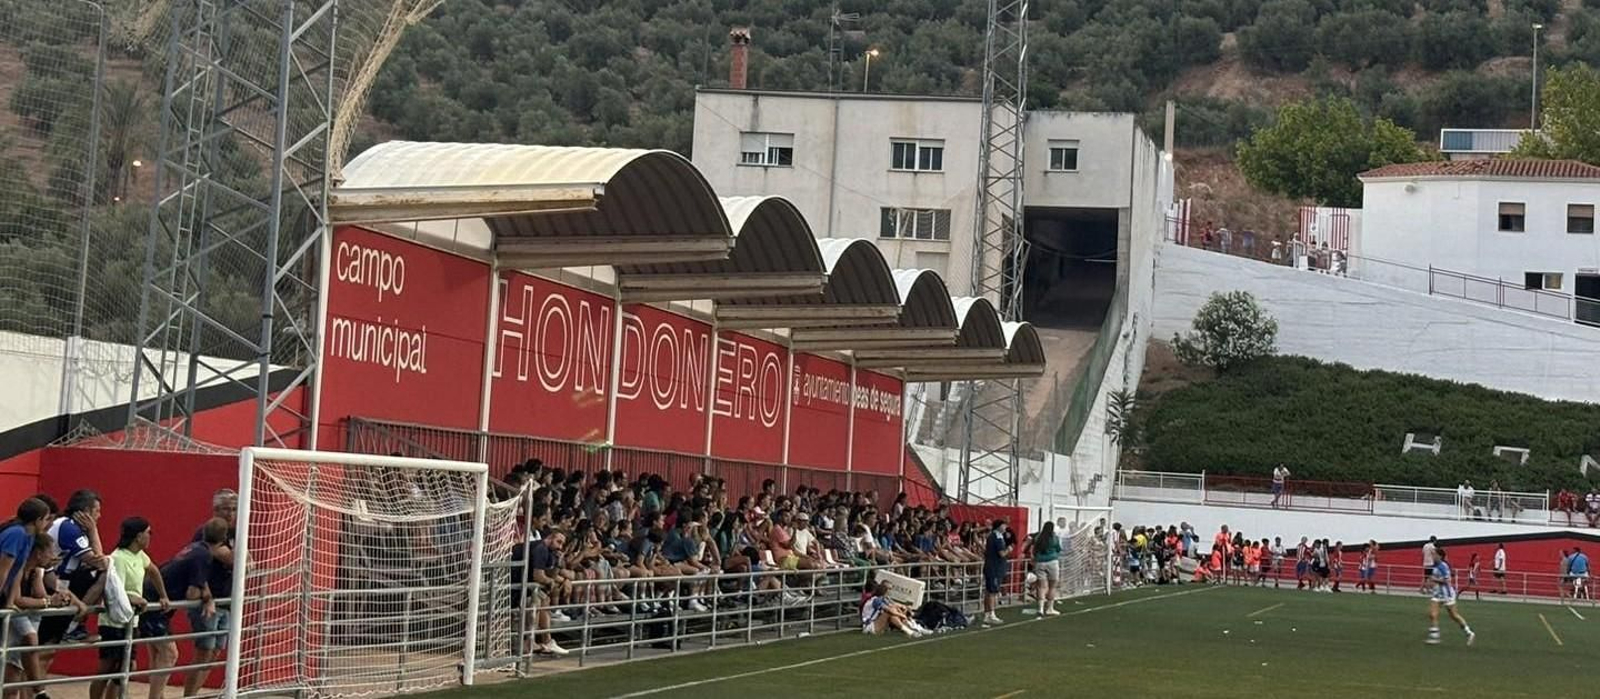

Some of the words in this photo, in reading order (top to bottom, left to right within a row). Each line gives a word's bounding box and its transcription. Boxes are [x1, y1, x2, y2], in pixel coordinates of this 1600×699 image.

[336, 240, 405, 302] campo
[330, 315, 427, 383] municipal
[491, 278, 782, 428] HONDONERO
[803, 373, 850, 406] ayuntamiento
[870, 384, 879, 411] de
[880, 390, 901, 422] segura
